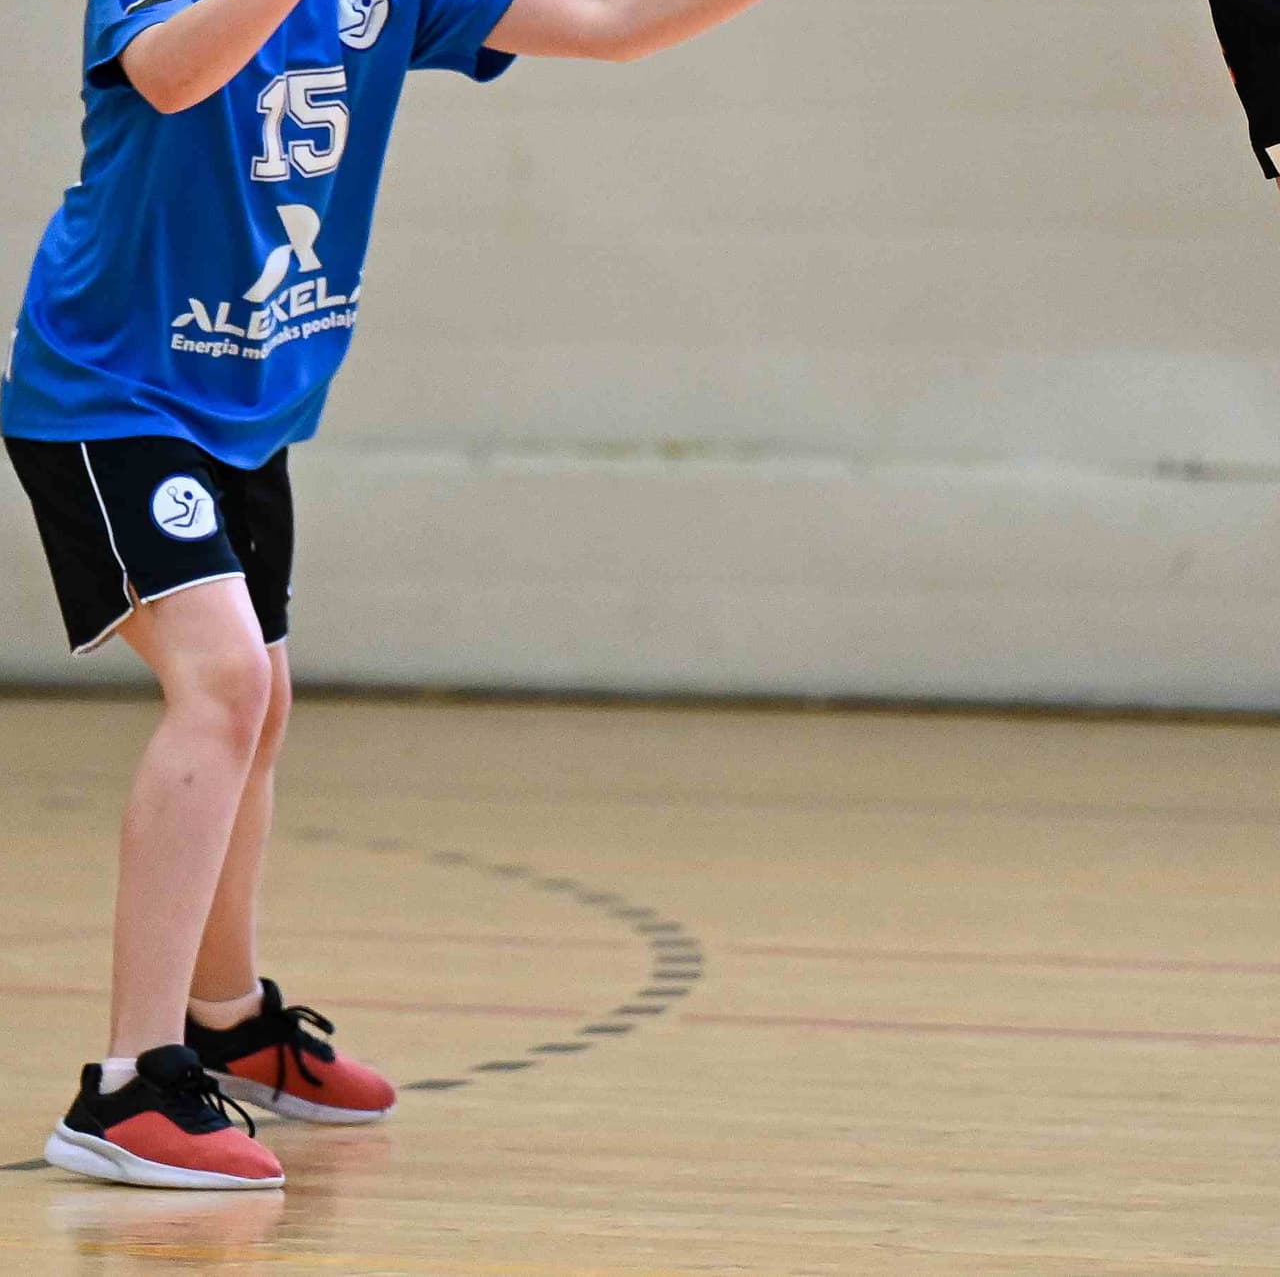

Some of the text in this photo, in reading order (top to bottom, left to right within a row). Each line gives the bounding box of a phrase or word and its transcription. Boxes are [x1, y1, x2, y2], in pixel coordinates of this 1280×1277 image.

[250, 65, 349, 182] 15
[170, 276, 361, 341] ALEXEL
[170, 332, 239, 358] Energia
